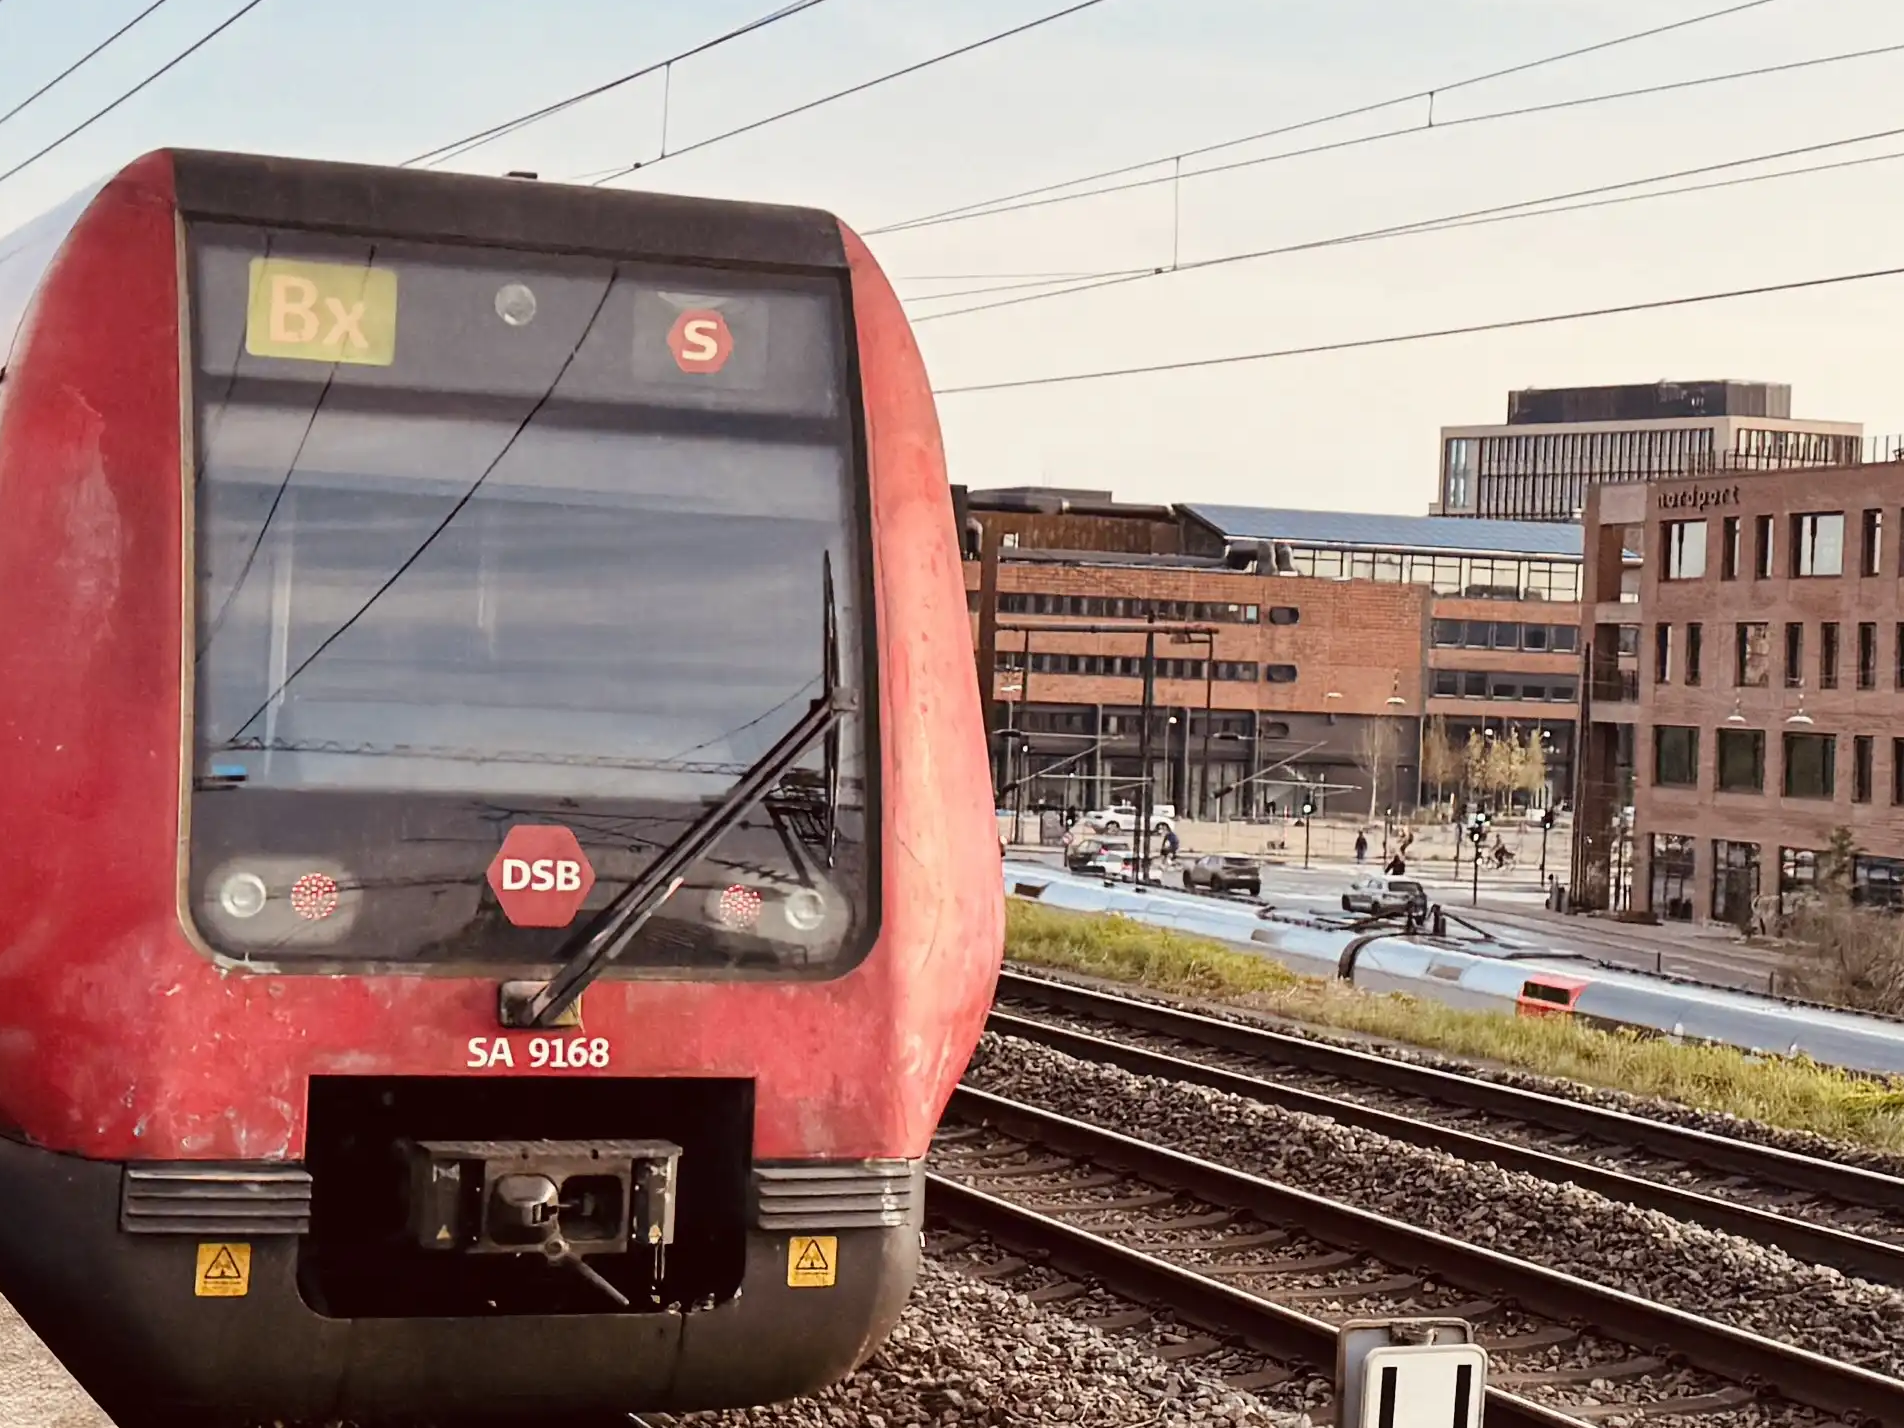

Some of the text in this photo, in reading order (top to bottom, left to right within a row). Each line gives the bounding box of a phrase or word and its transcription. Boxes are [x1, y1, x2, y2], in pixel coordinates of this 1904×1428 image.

[270, 274, 369, 348] Bx
[682, 320, 718, 361] S
[502, 858, 582, 891] DSB
[467, 1037, 610, 1068] SA 9168
